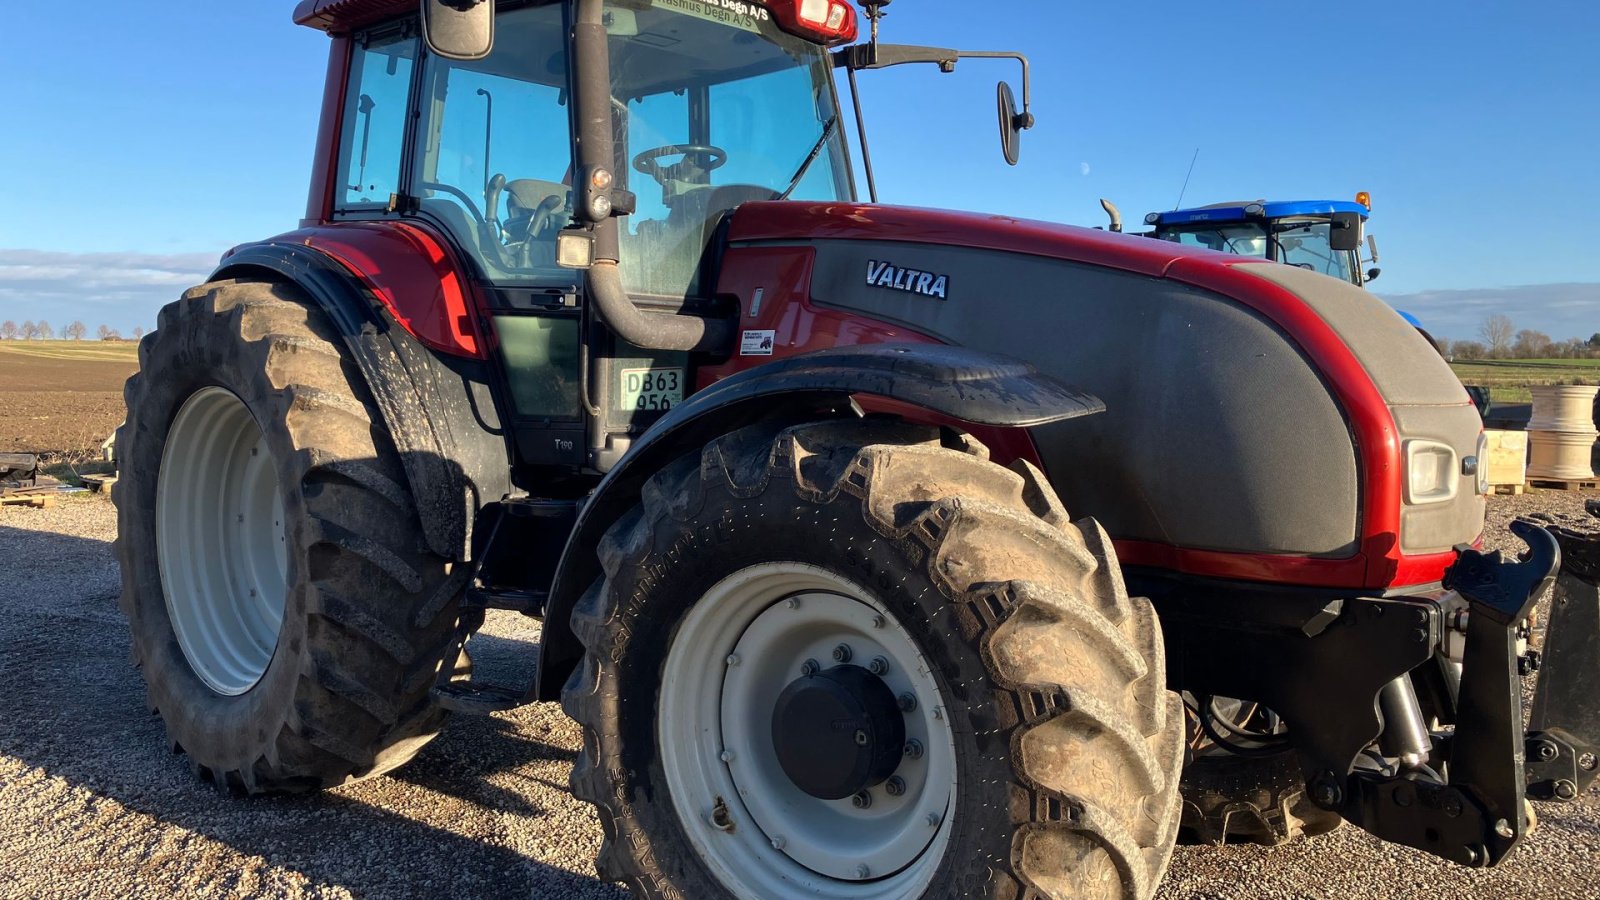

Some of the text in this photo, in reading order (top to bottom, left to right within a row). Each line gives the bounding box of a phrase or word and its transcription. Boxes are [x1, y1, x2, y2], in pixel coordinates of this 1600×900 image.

[704, 4, 730, 21] Degn
[733, 14, 752, 27] A/S
[722, 0, 748, 15] Degn
[750, 5, 769, 20] A/S
[866, 260, 949, 299] VALTRA
[628, 371, 678, 393] DB63
[637, 394, 671, 411] 956
[554, 438, 573, 450] T190
